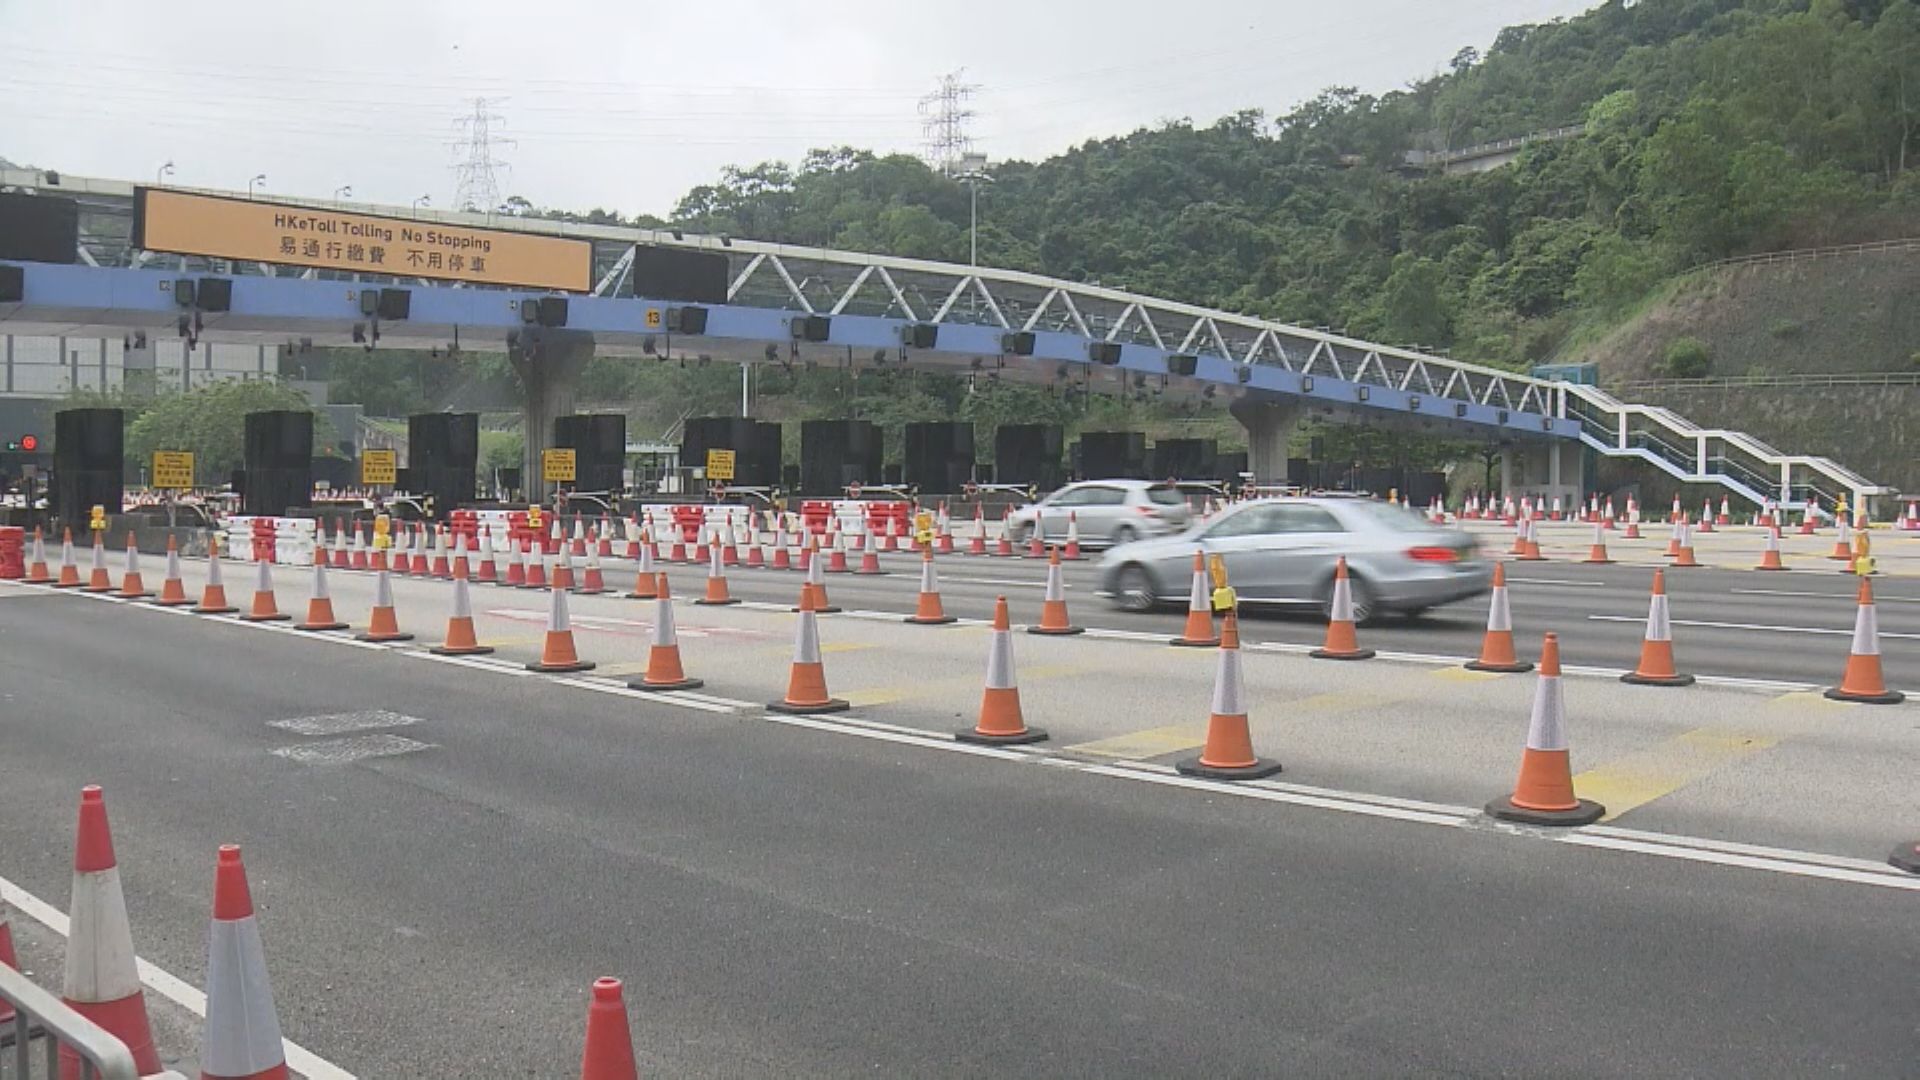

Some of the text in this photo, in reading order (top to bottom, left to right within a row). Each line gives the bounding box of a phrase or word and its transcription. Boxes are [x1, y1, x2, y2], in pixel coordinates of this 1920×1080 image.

[274, 214, 491, 252] HKeToll Tolling No Stopping
[279, 236, 486, 272] 易通行繳費 不用停車
[648, 311, 660, 324] 13
